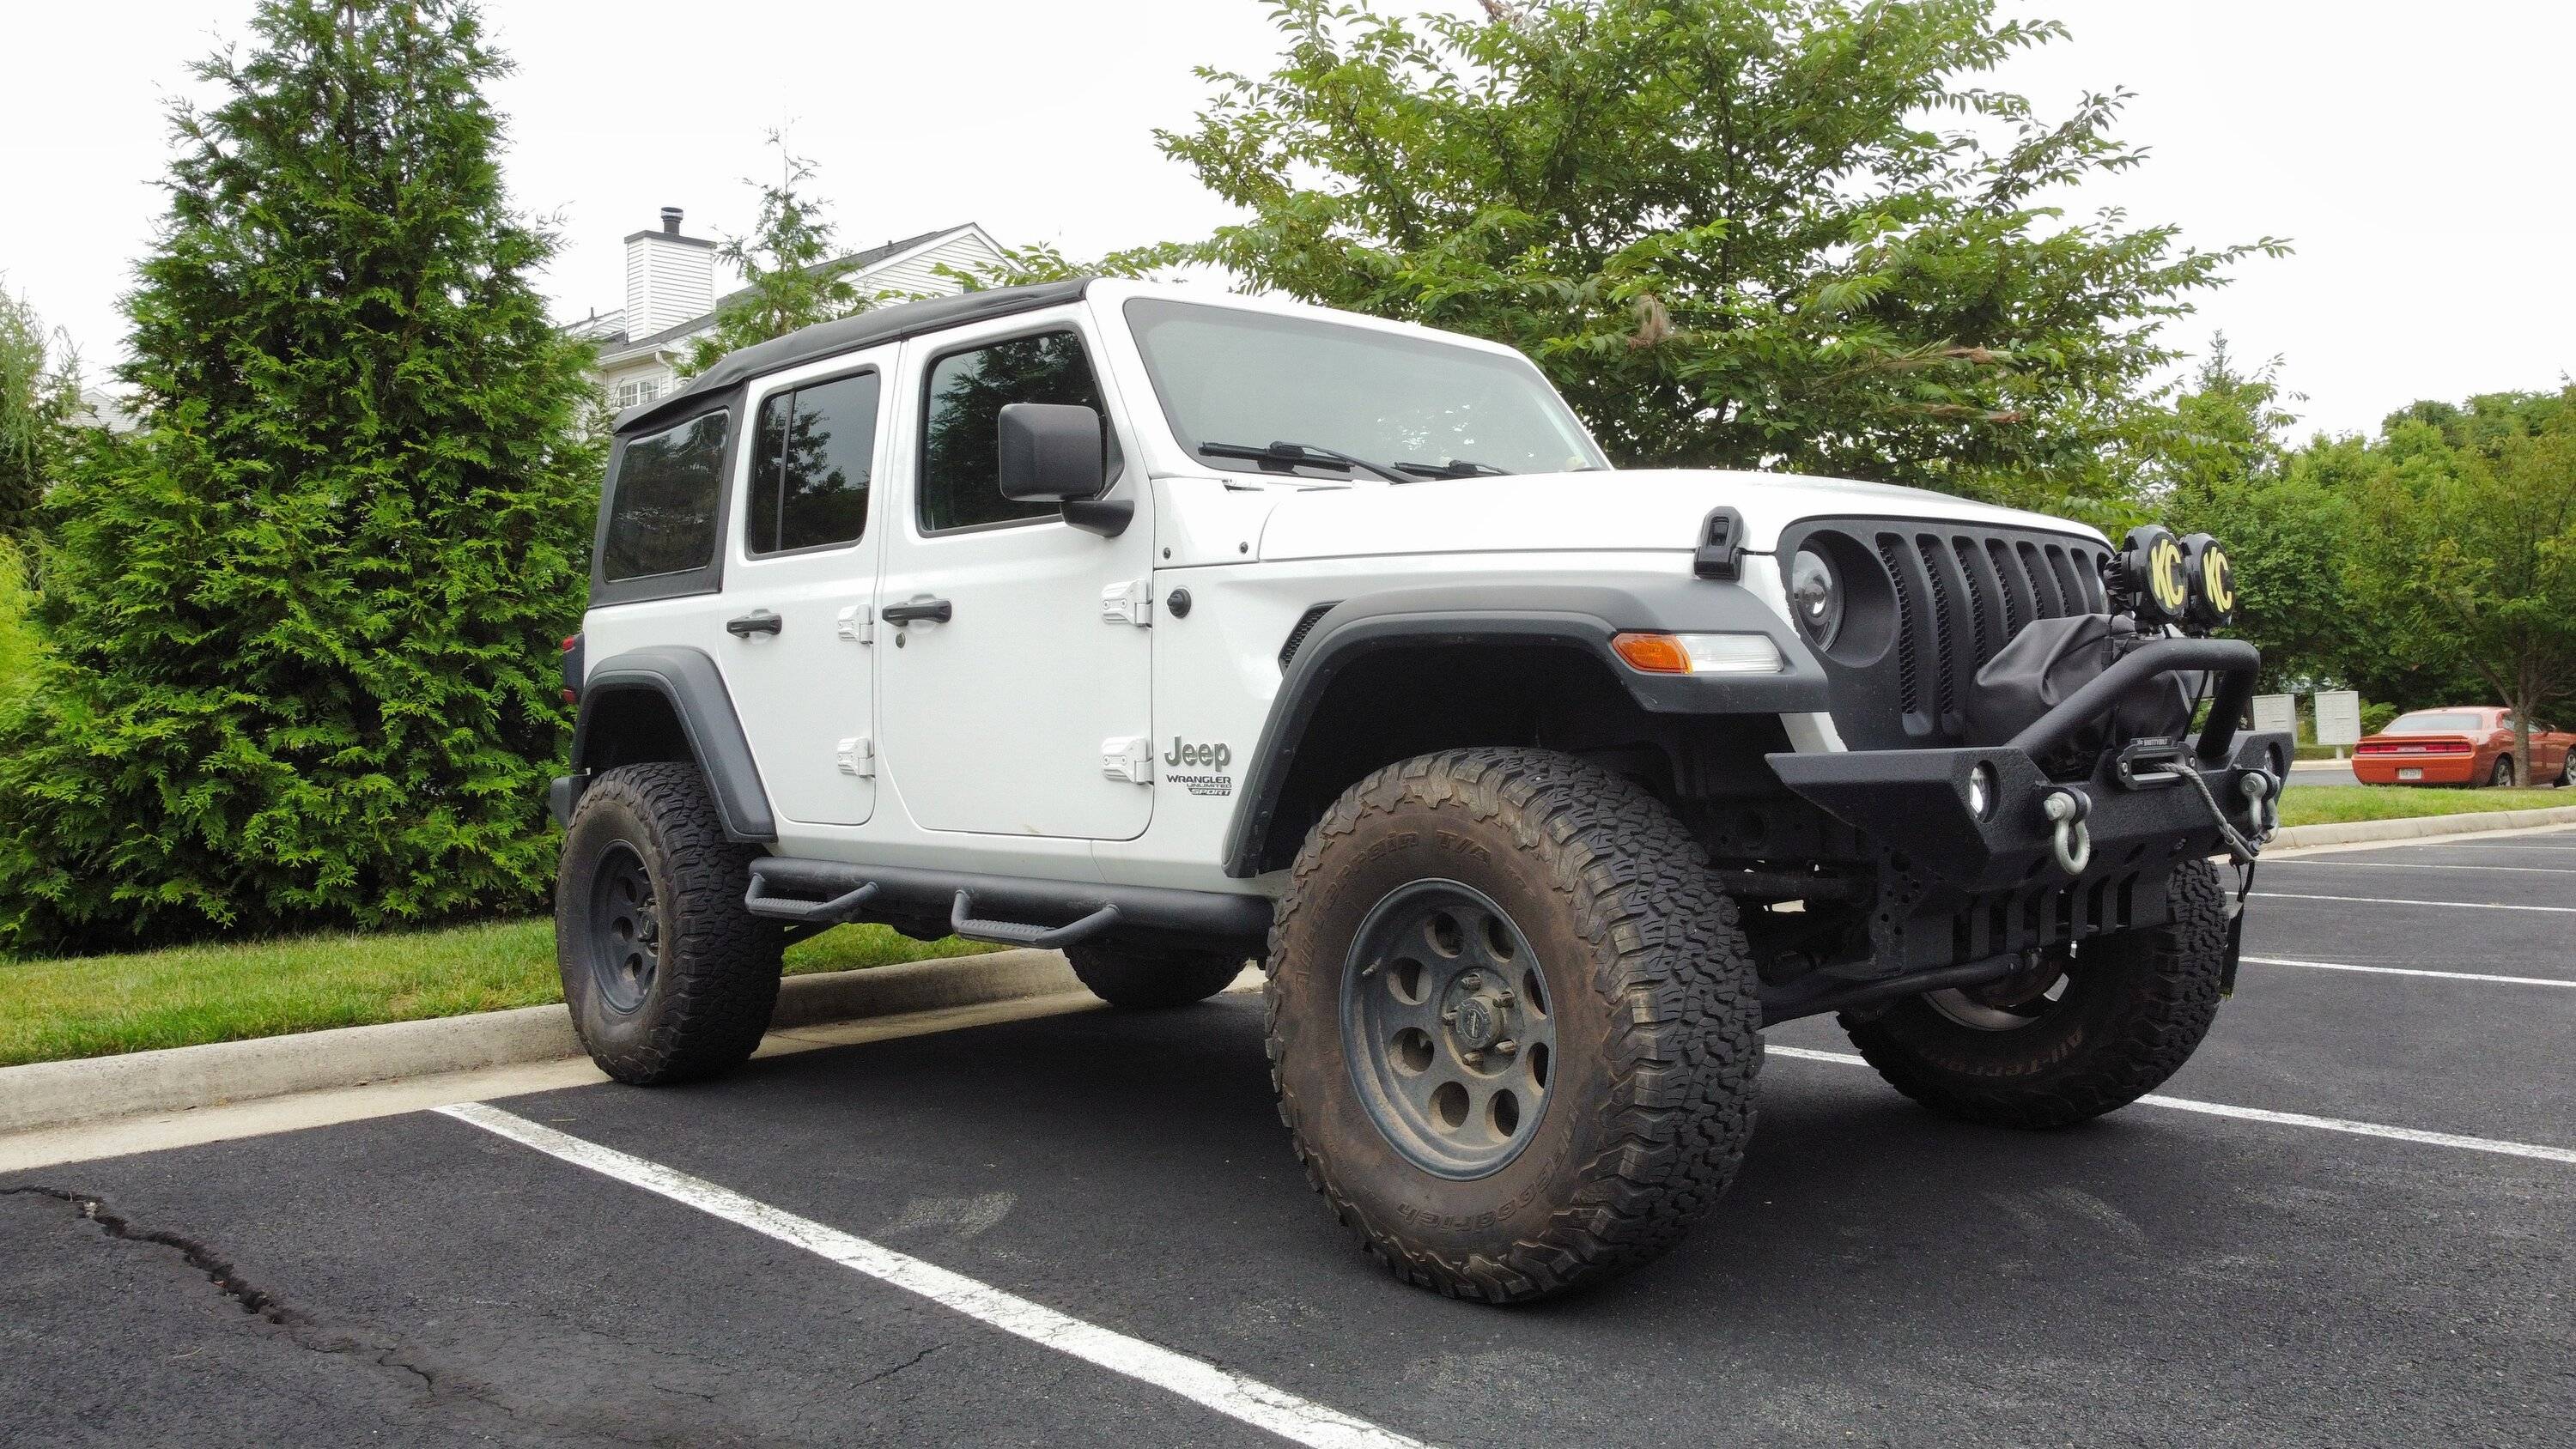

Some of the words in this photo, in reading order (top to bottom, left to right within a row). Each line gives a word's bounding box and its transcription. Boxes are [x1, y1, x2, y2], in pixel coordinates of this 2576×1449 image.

[2151, 539, 2184, 609] KC
[2203, 547, 2232, 613] KC
[1164, 736, 1230, 772] Jeep
[1166, 774, 1231, 784] WRANGLER
